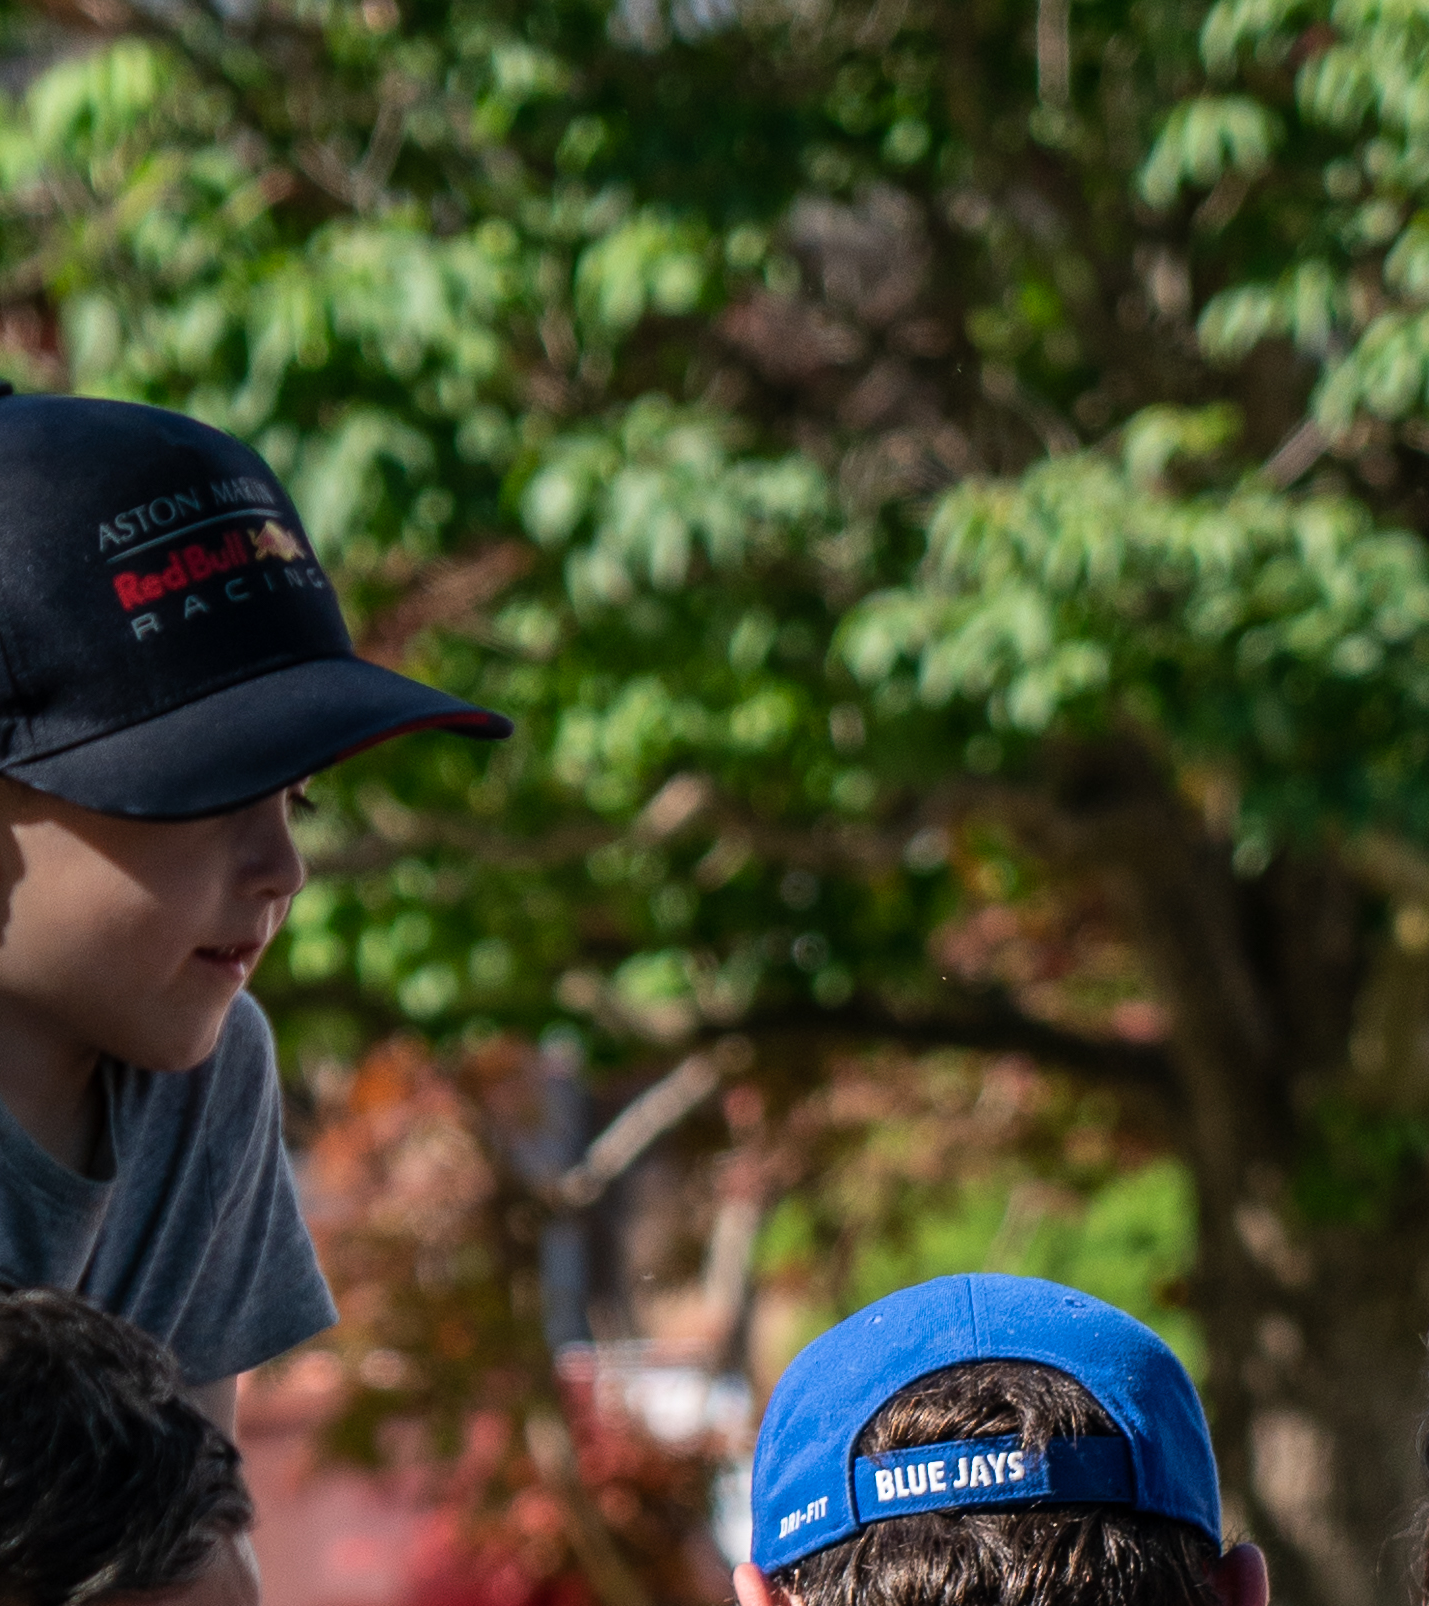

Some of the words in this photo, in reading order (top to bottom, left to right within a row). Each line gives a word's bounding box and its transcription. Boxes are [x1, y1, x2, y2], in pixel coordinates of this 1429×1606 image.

[98, 486, 201, 553] ASTON
[114, 551, 188, 611] Red
[130, 567, 324, 641] RACING
[875, 1461, 947, 1502] BLUE
[952, 1450, 1026, 1489] JAYS
[778, 1495, 829, 1539] DRI-FIT
